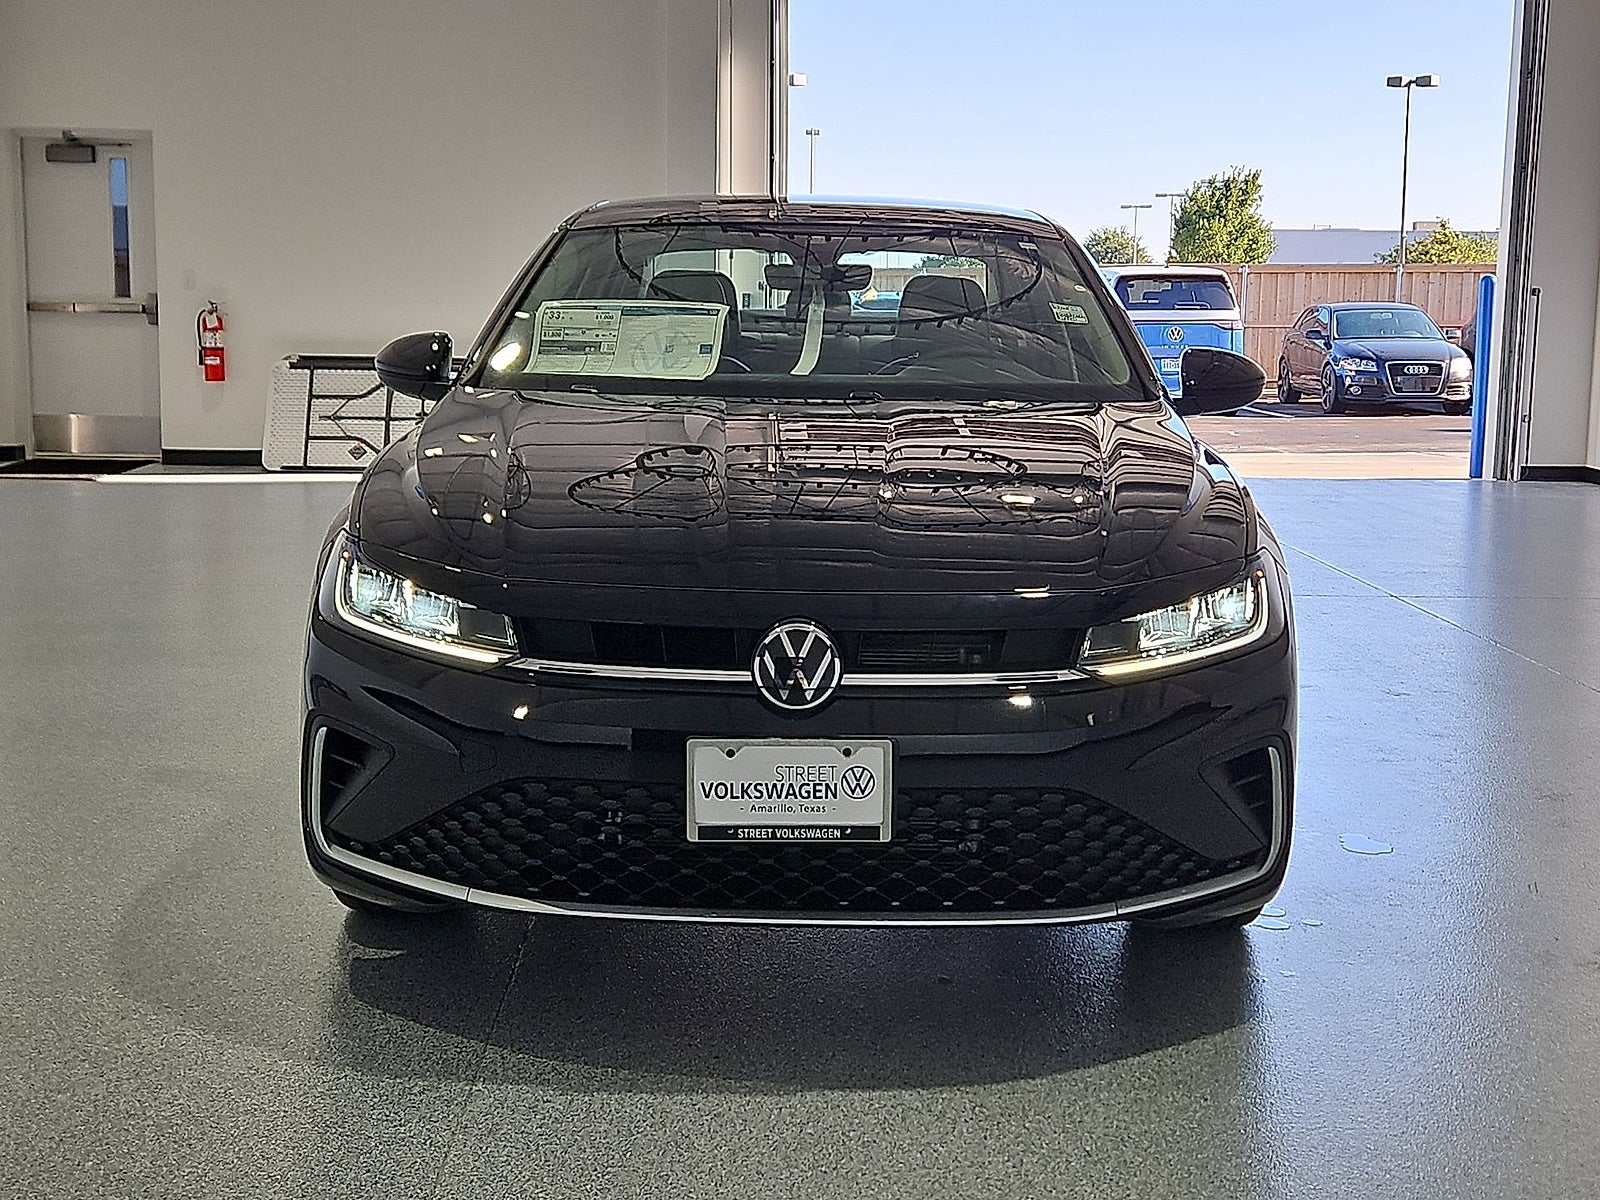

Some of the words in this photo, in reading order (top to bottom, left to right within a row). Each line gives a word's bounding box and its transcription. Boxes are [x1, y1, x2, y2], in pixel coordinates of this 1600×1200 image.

[775, 765, 838, 783] STREET
[700, 782, 838, 800] VOLKSWAGEN
[749, 803, 797, 815] Amarillo,
[798, 803, 827, 814] Texas
[737, 828, 774, 839] STREET
[775, 828, 841, 839] VOLKSWAGEN
